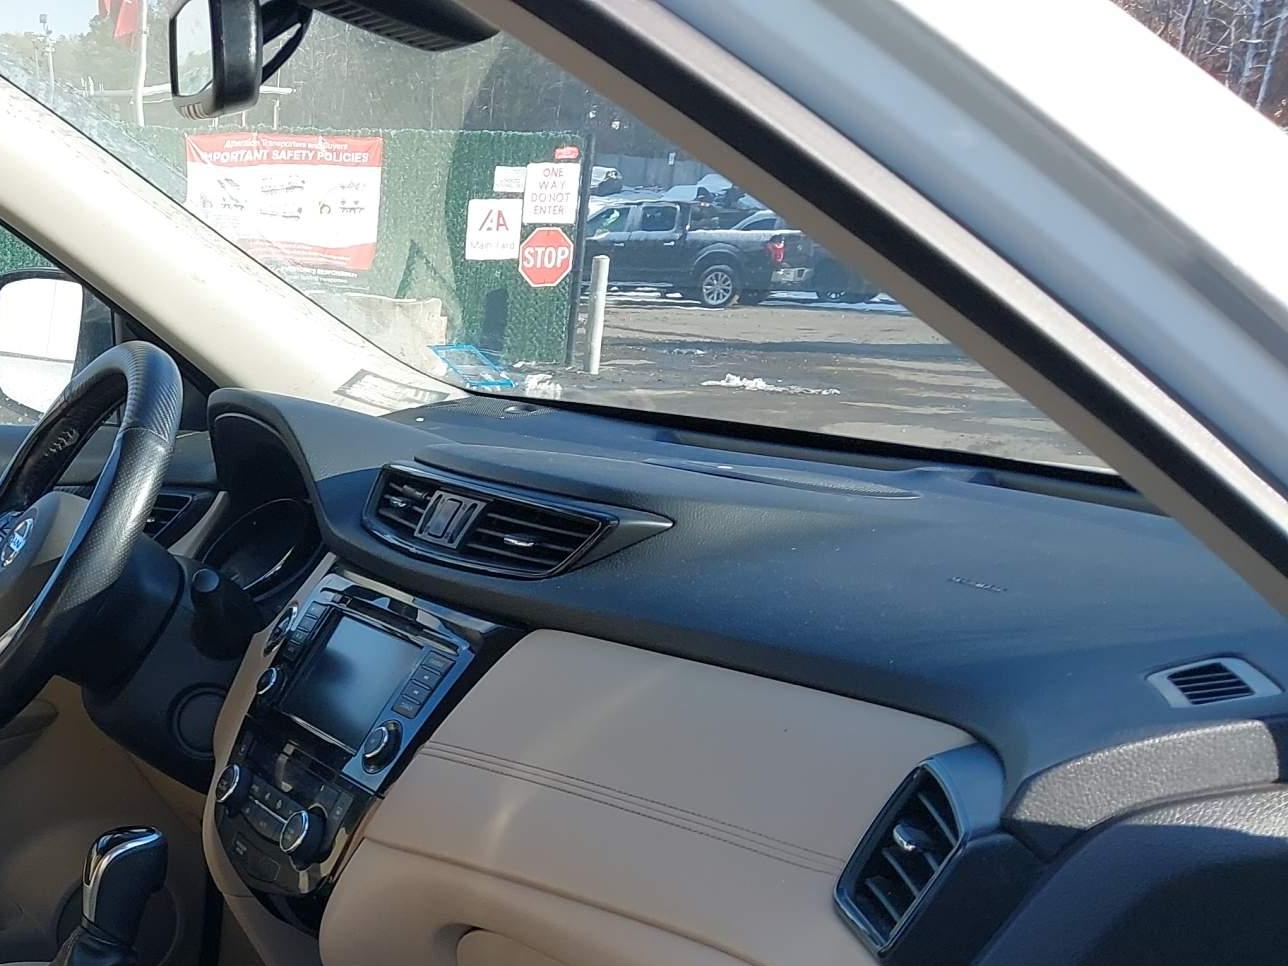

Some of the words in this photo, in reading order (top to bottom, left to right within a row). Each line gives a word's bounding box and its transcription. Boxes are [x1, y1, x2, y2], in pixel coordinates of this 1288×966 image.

[201, 149, 268, 163] IMPORTANT
[272, 150, 313, 162] SAFETY
[317, 151, 369, 163] POLICIES
[543, 167, 564, 178] ONE
[538, 181, 566, 190] WAY
[531, 192, 548, 202] DO
[549, 192, 571, 203] NOT
[533, 205, 565, 216] ENTER
[523, 246, 570, 269] STOP
